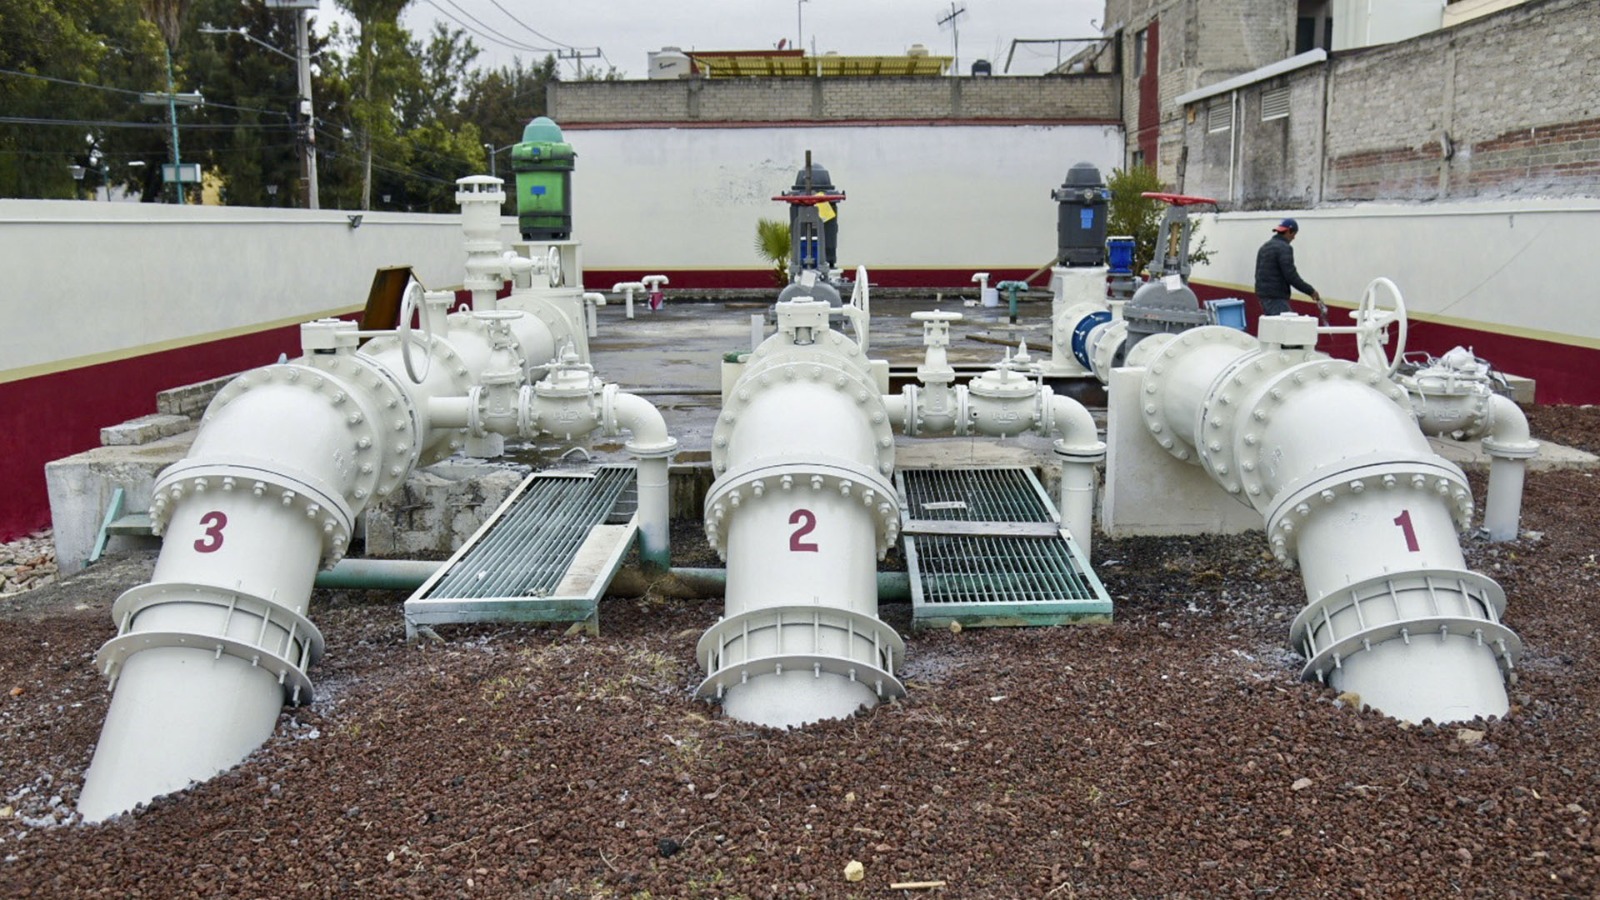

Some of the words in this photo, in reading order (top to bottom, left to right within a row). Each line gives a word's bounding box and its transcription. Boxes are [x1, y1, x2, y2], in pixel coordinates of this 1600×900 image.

[194, 511, 227, 552] 3
[789, 509, 818, 551] 2
[1394, 510, 1419, 551] 1
